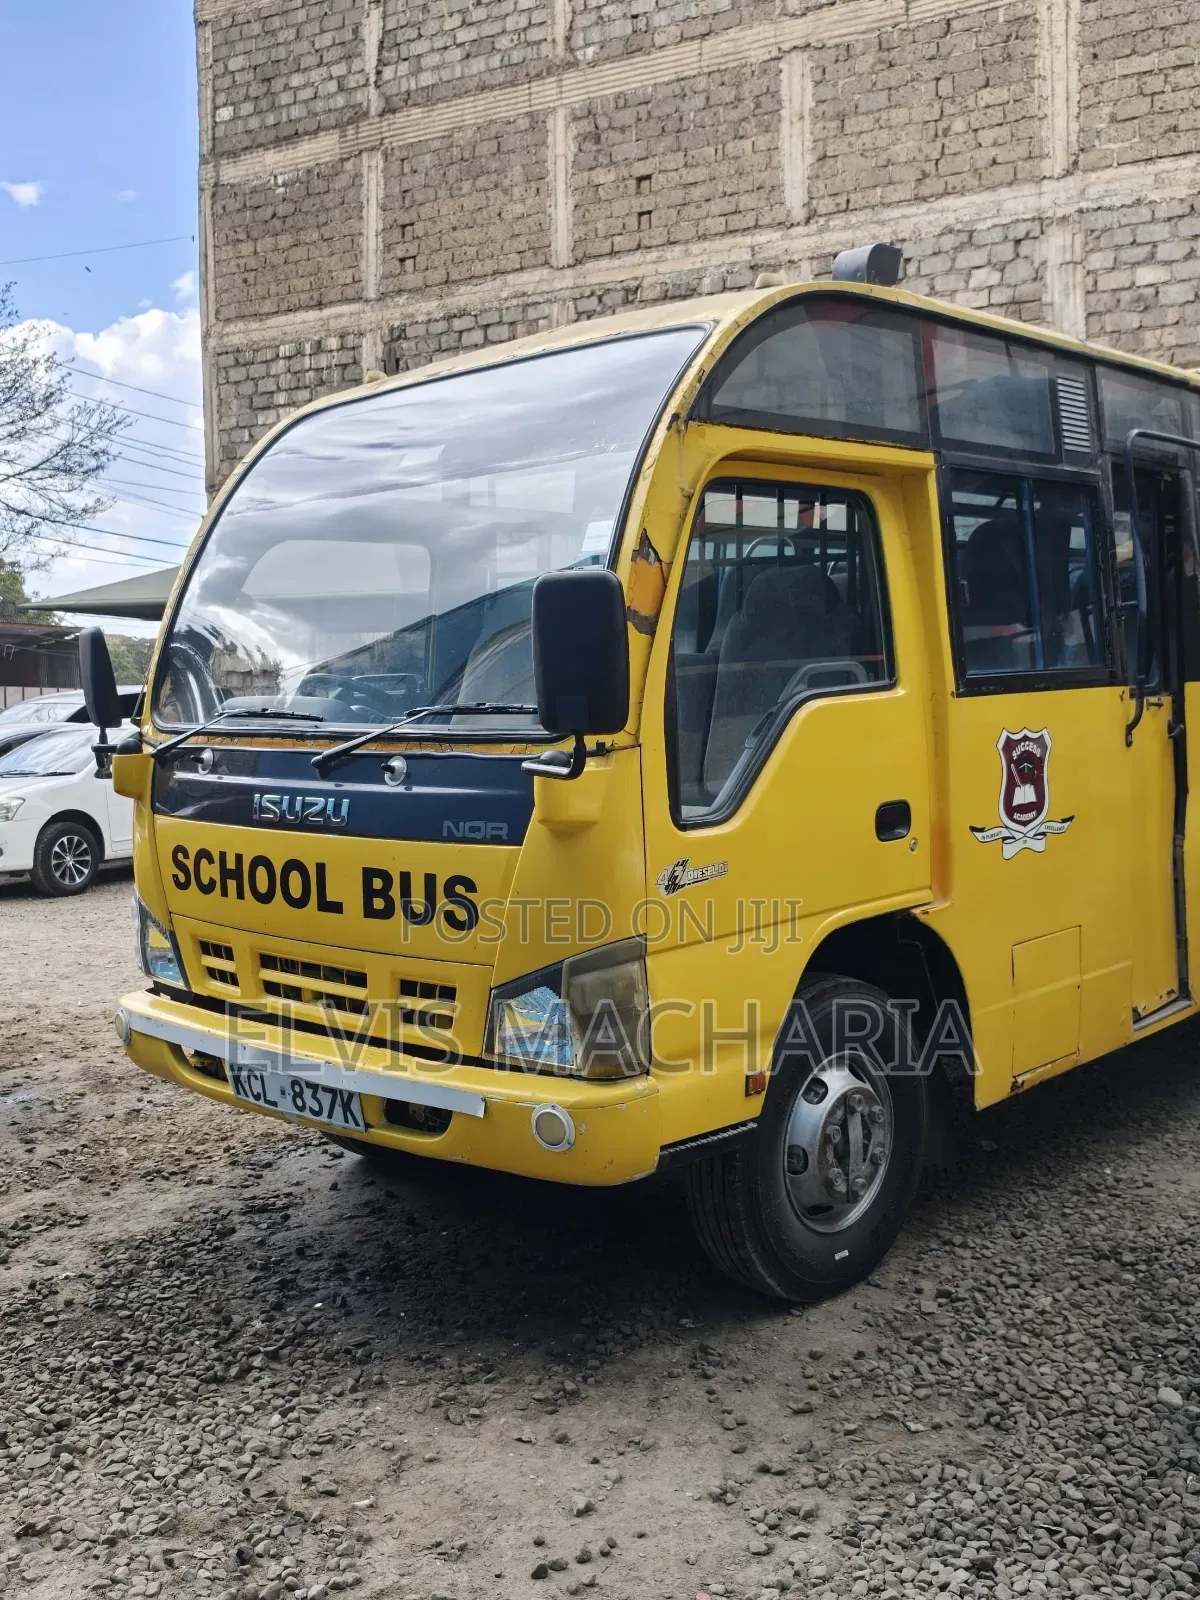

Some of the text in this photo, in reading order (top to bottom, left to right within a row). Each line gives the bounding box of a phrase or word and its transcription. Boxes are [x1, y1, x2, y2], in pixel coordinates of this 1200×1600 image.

[1012, 741, 1041, 760] SUCCESS
[252, 793, 350, 827] ISUZU
[1012, 810, 1037, 821] ACADEMY
[442, 820, 509, 840] NQR
[171, 844, 479, 932] SCHOOL BUS
[229, 1064, 361, 1127] KCL 837K
